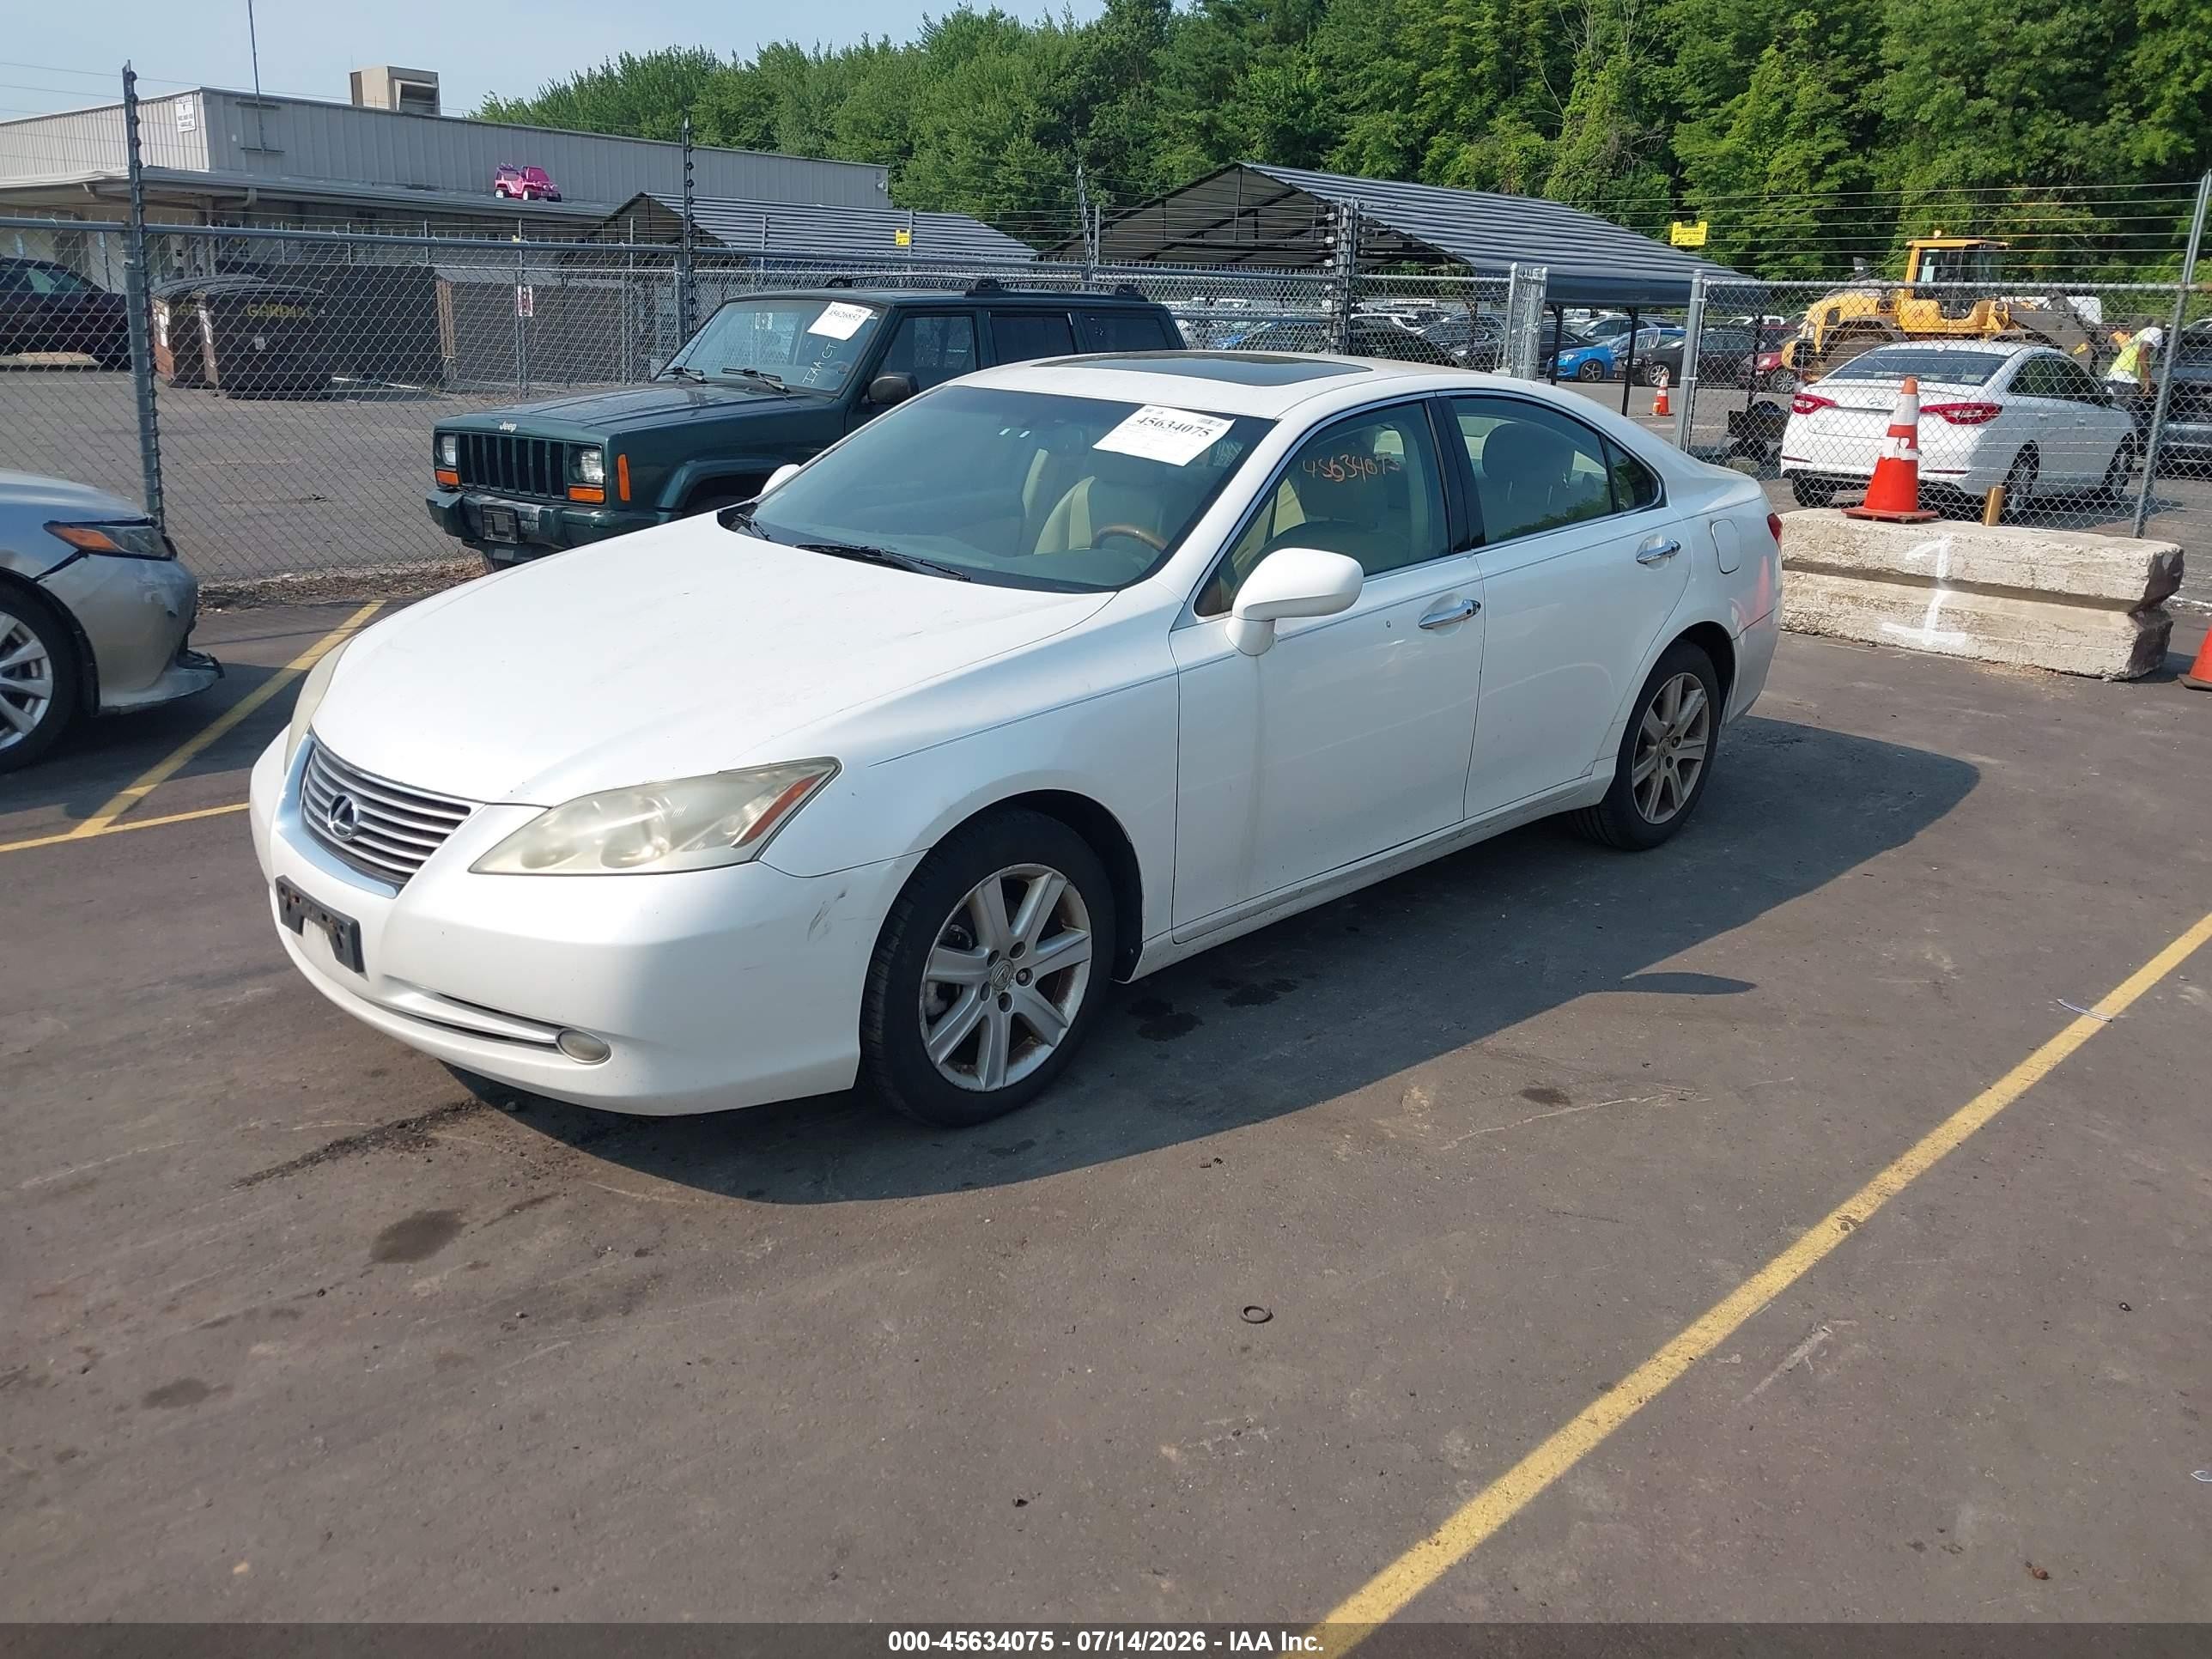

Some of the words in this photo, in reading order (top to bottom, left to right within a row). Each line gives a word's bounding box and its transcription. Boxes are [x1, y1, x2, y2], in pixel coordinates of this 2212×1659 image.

[802, 361, 824, 385] IAA
[822, 342, 837, 359] CT
[500, 421, 517, 433] Jeep
[1137, 416, 1213, 437] 45634075
[1881, 533, 1967, 647] 1
